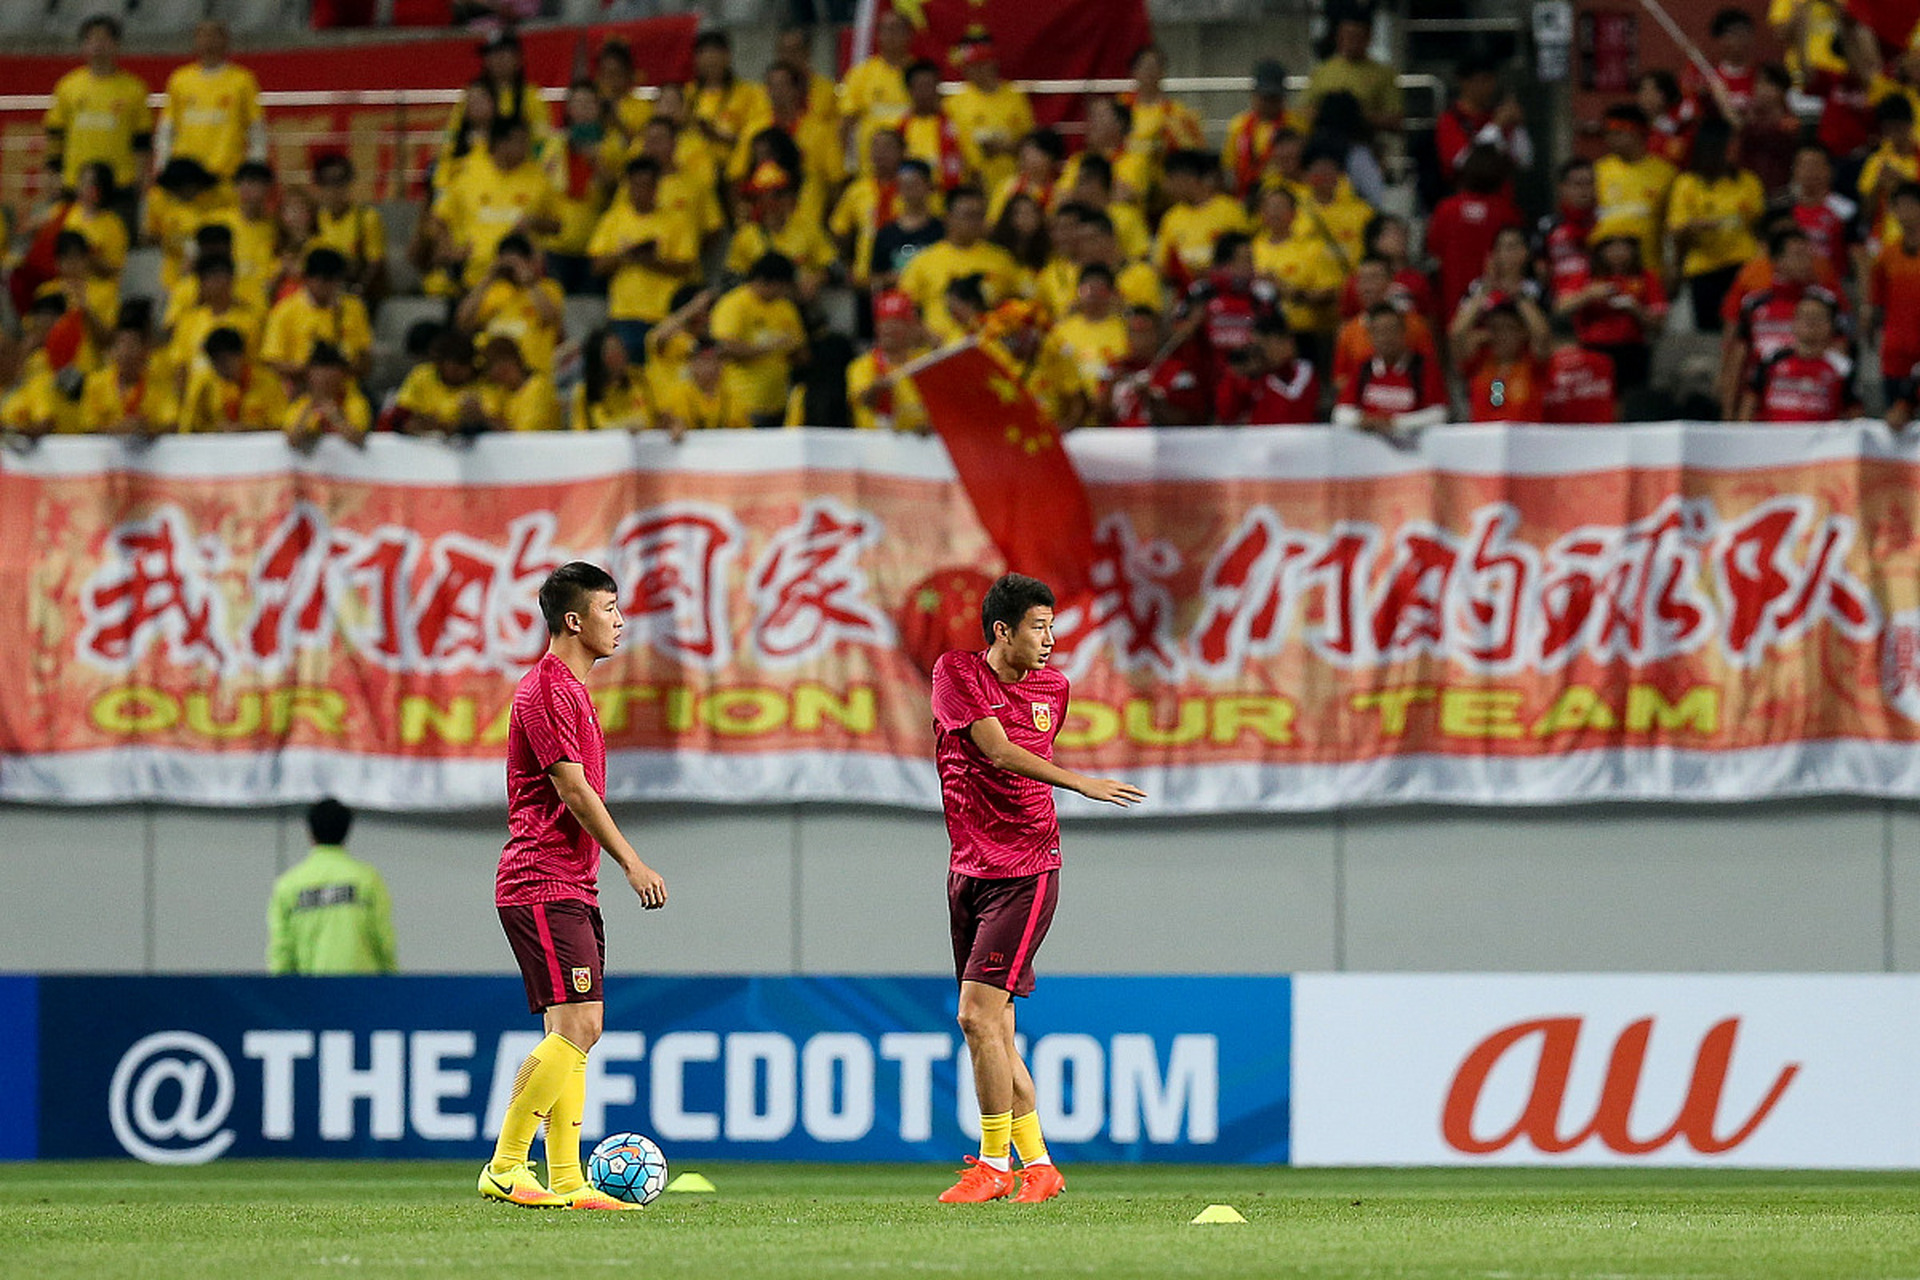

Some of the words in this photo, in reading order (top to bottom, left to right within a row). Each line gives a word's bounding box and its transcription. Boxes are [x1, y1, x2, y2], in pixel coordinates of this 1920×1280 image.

[92, 686, 346, 740] OUR
[1055, 695, 1294, 746] OUR
[1351, 684, 1720, 738] TEAM
[1440, 1015, 1802, 1156] au
